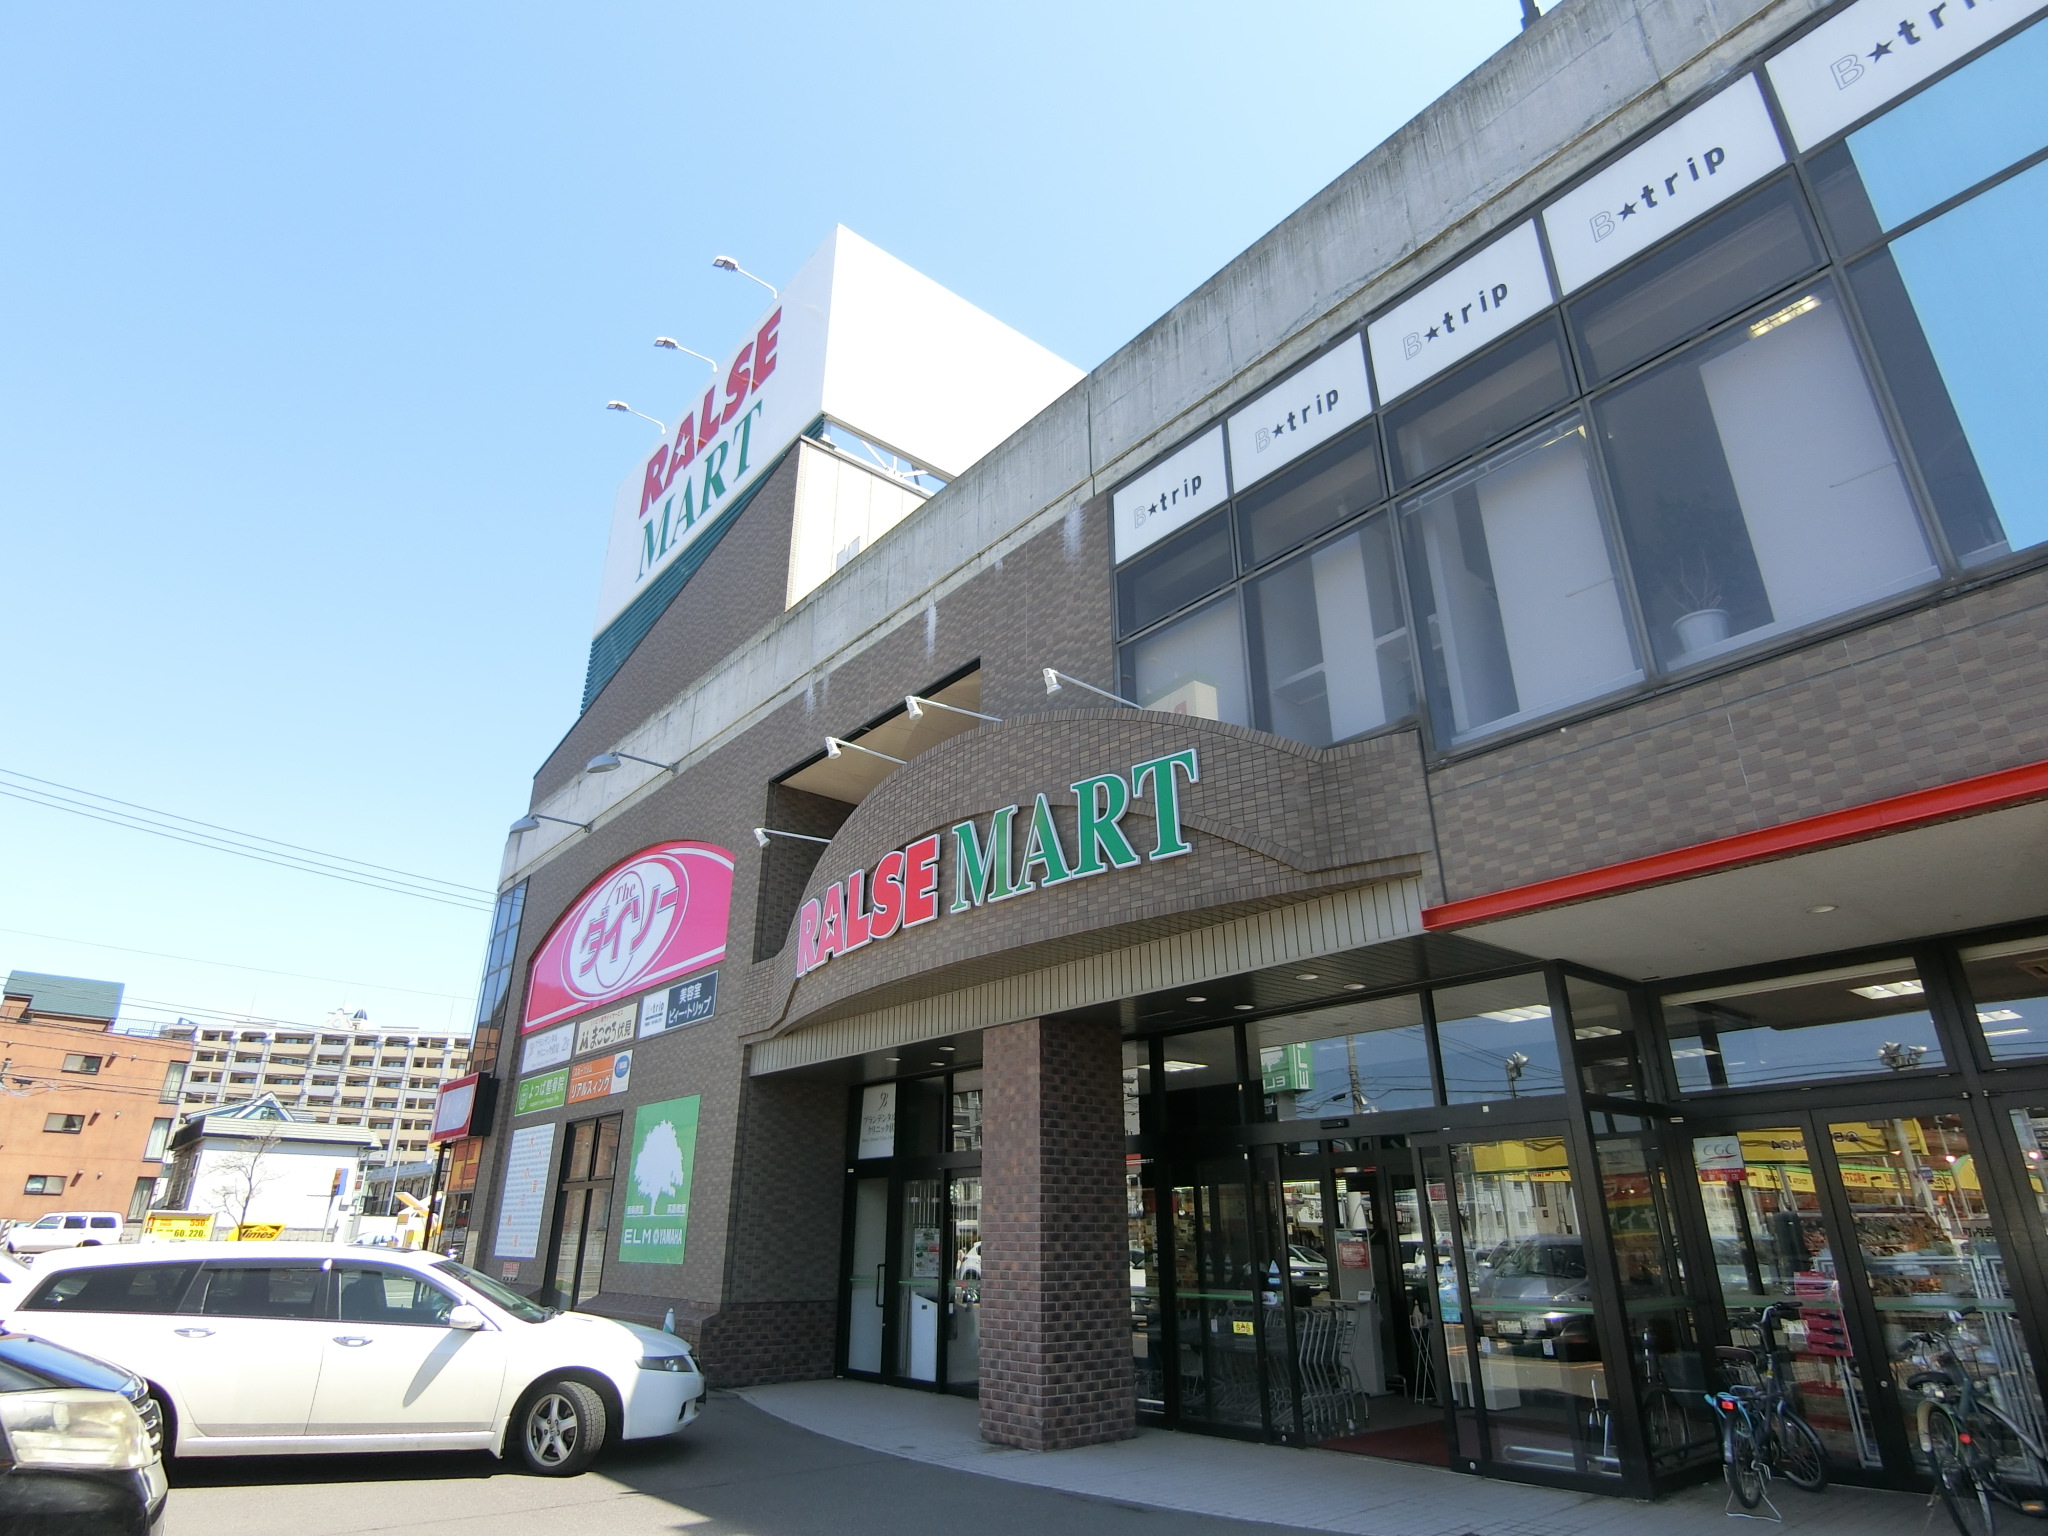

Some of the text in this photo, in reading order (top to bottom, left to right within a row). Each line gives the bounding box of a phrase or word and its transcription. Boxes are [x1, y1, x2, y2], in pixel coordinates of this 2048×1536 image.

[638, 305, 782, 520] RALSE
[635, 399, 763, 583] MART
[796, 748, 1199, 978] RALSE MART
[615, 882, 635, 905] The
[578, 884, 680, 978] ダイソー
[679, 982, 702, 1004] 美容室
[1703, 1143, 1735, 1156] CGC
[623, 1228, 683, 1245] ELM YAMAHA
